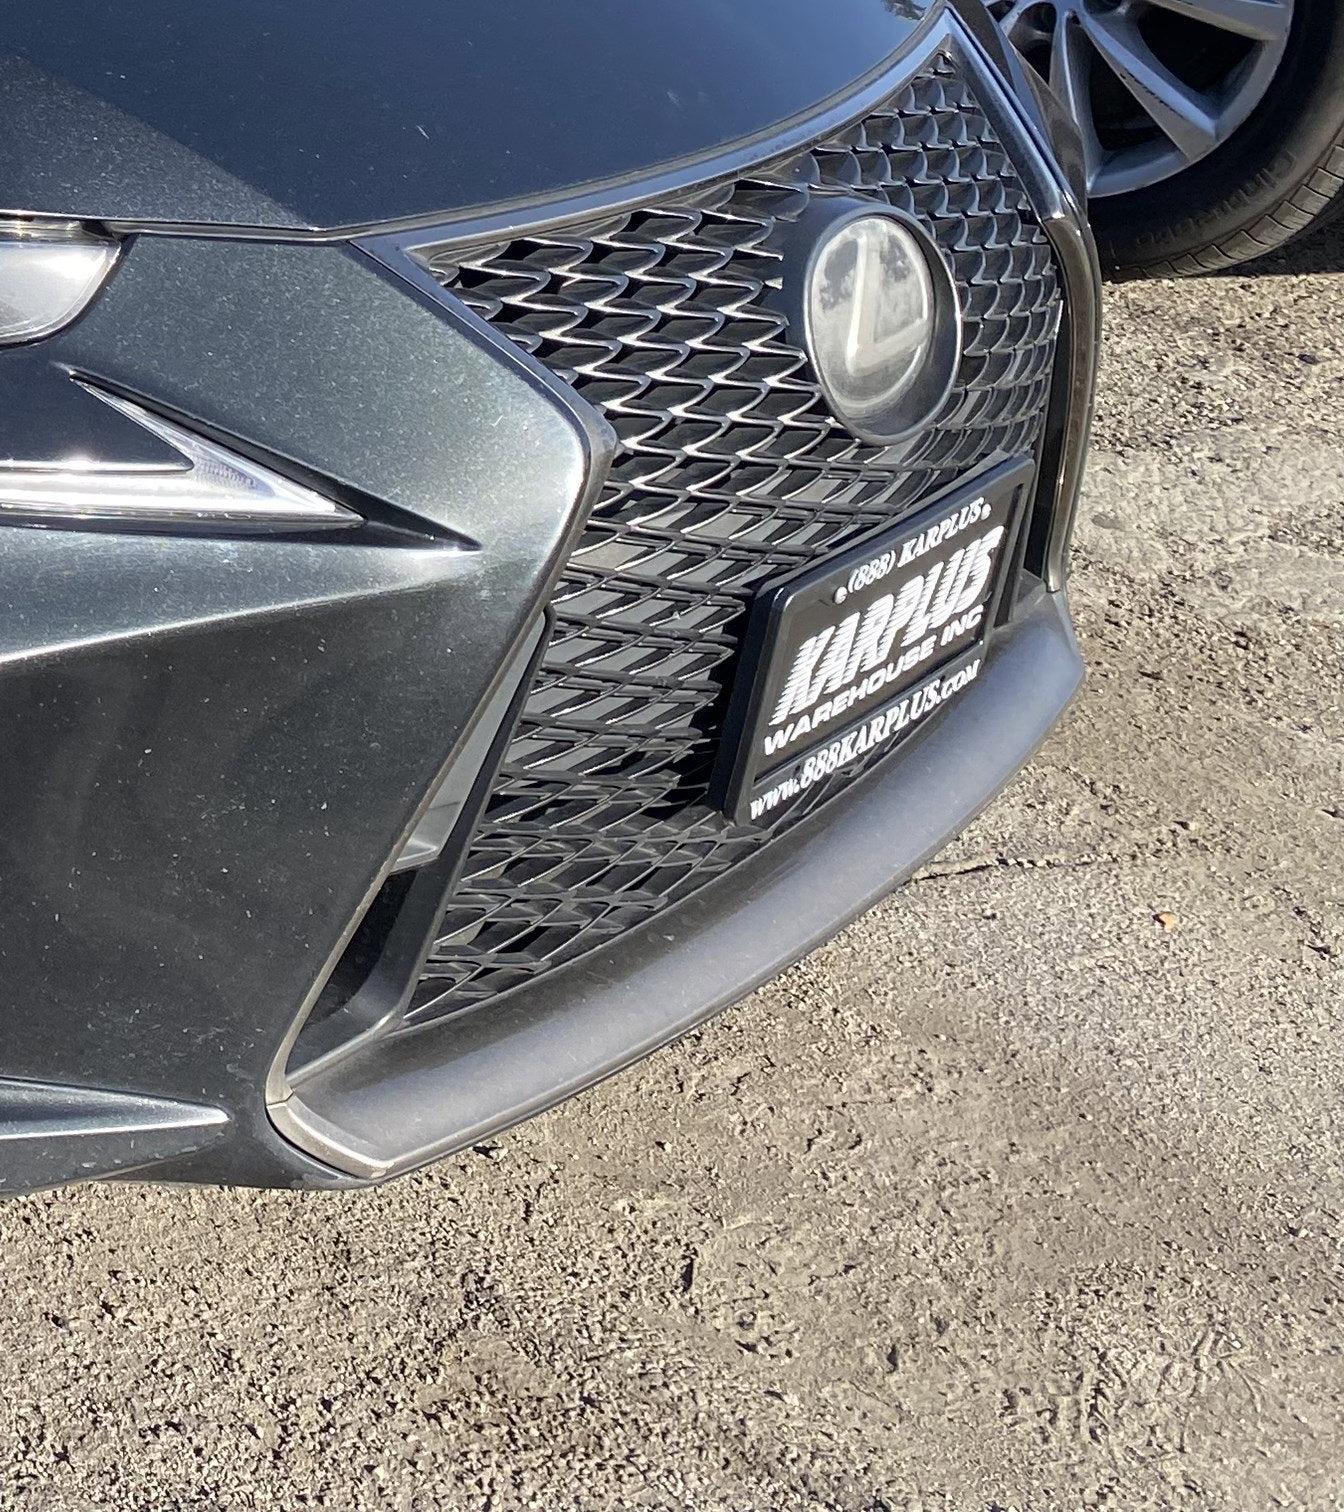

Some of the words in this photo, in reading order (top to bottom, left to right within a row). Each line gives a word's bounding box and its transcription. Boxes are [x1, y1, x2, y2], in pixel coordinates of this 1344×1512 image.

[847, 550, 897, 593] (888)
[896, 496, 985, 568] KARPLUS
[764, 634, 936, 757] WAREHOUSE
[940, 603, 984, 648] INC
